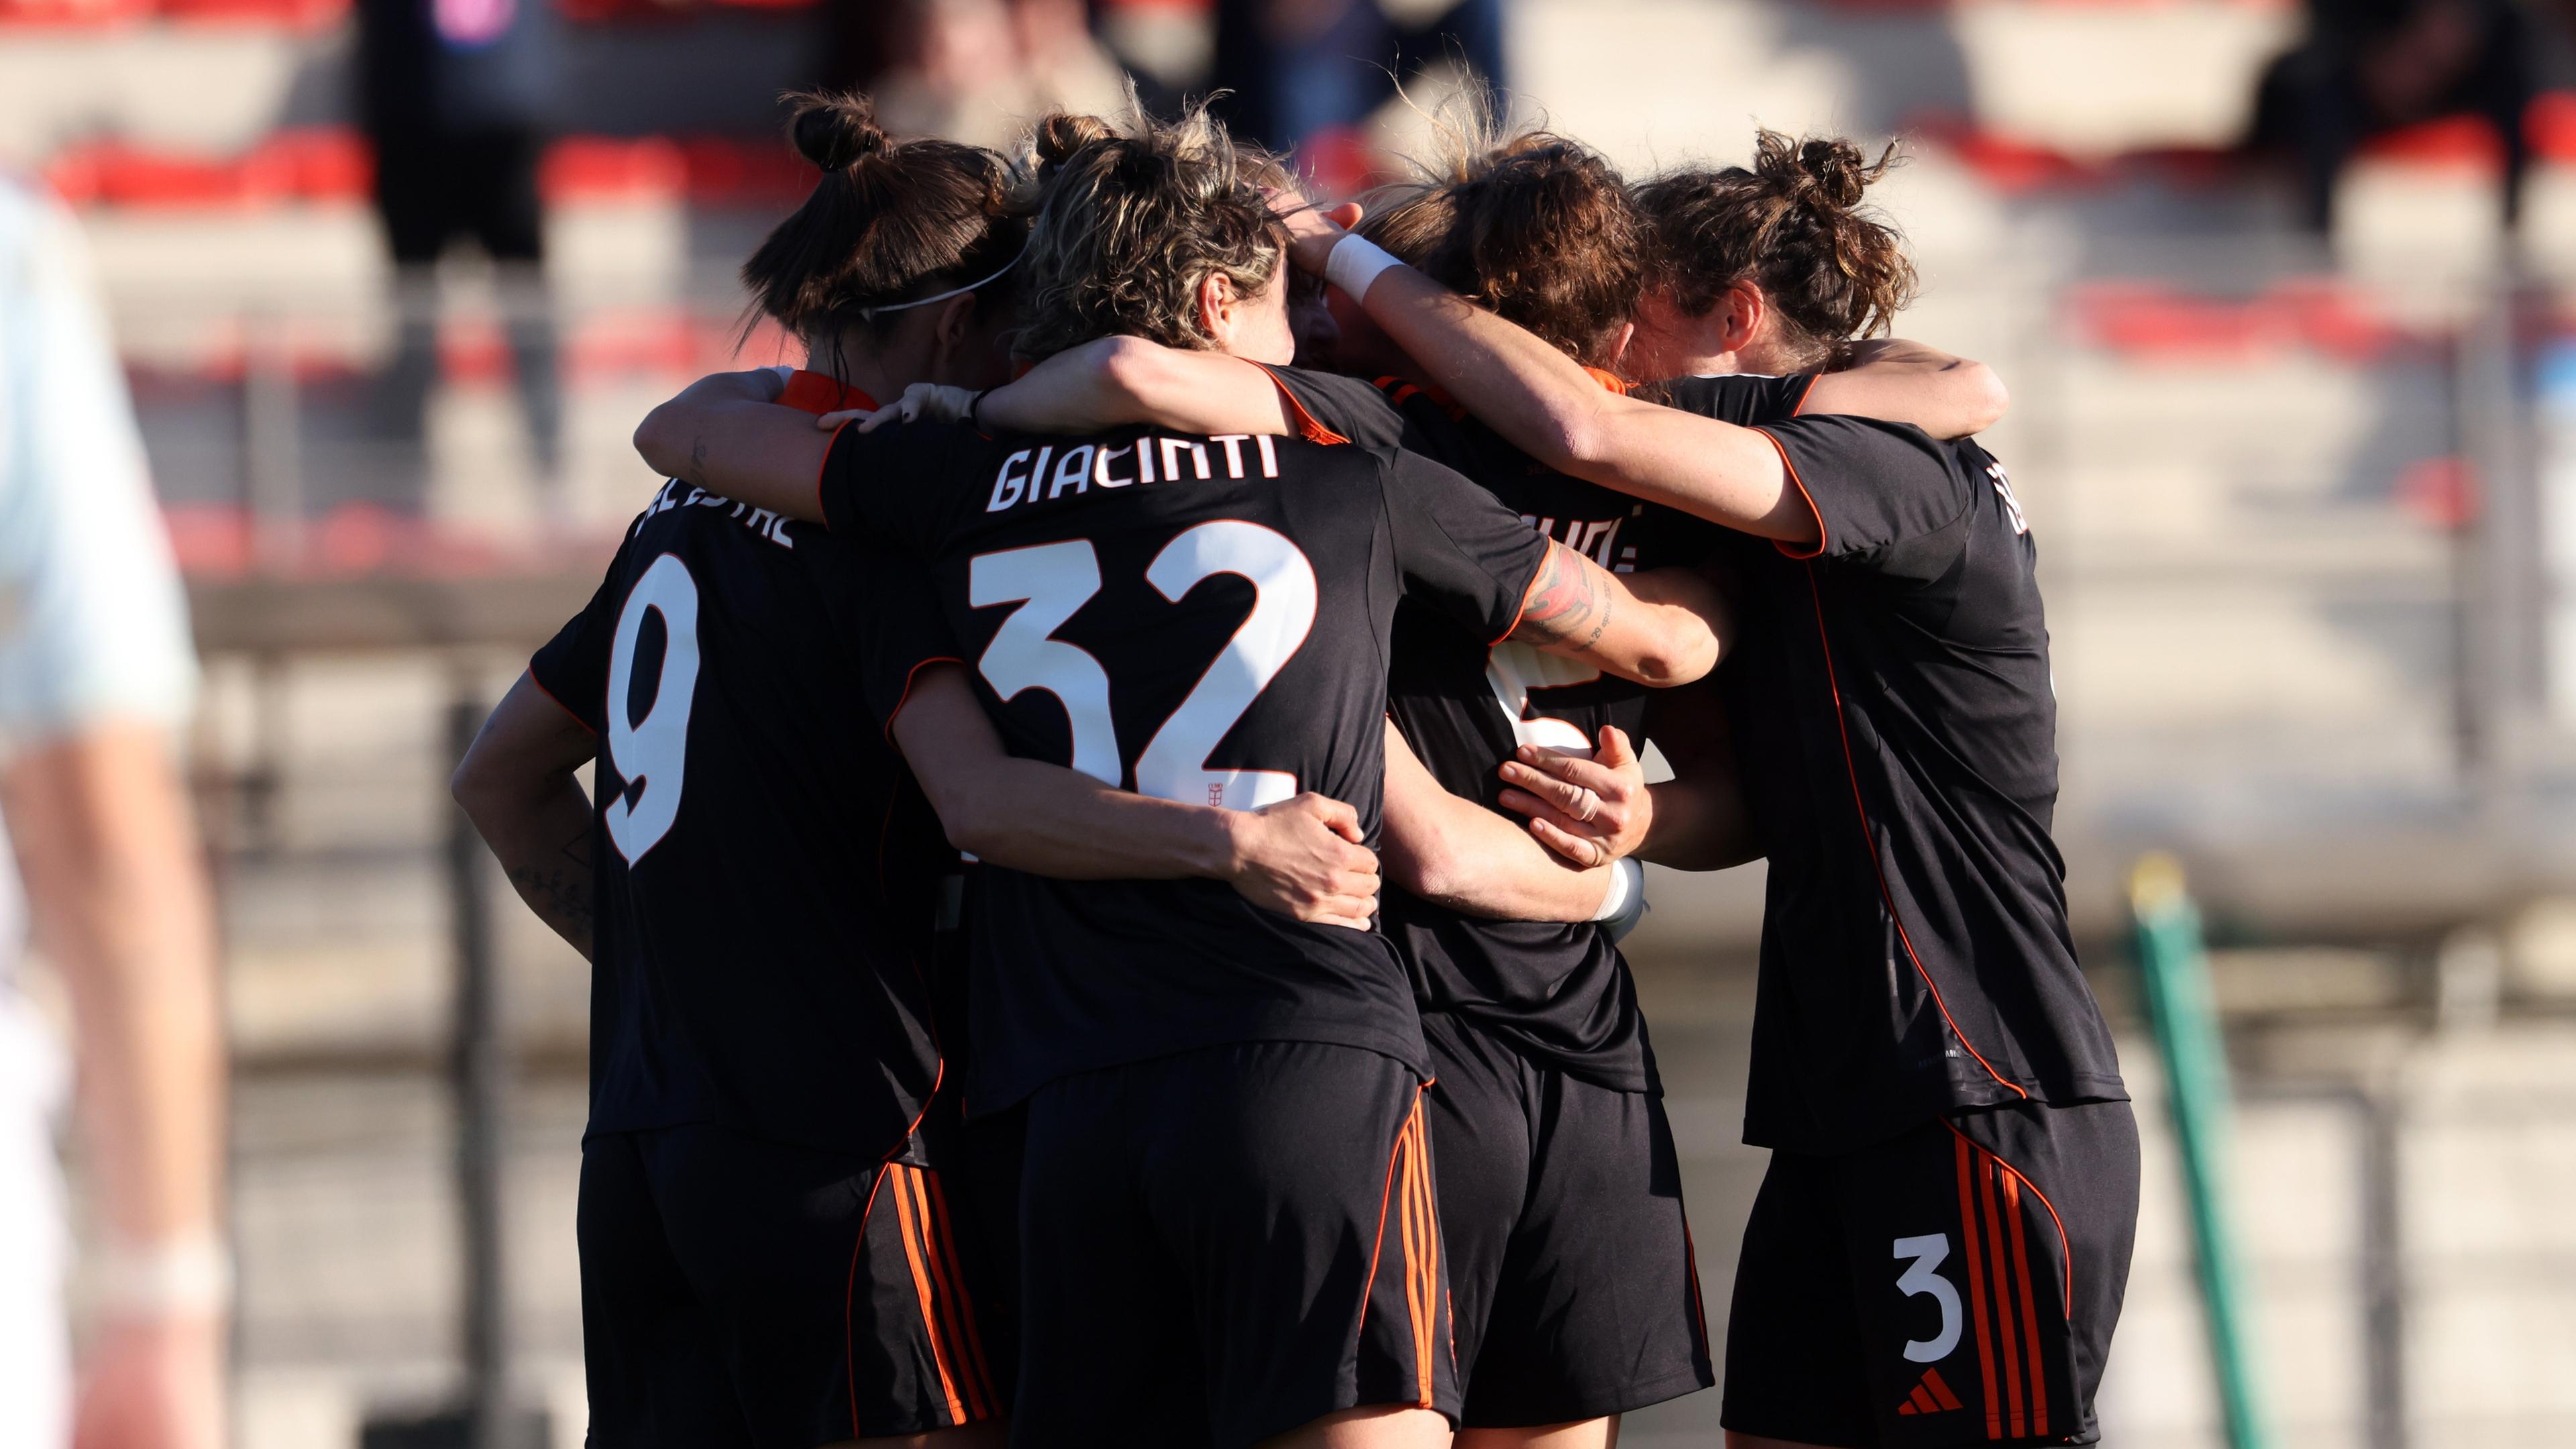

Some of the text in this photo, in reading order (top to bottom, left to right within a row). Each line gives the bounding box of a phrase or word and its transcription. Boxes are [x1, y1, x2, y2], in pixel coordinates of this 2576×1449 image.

[985, 434, 1279, 513] GIACINTI
[604, 552, 700, 871] 9
[969, 518, 1319, 813] 32
[1893, 1232, 1964, 1363] 3
